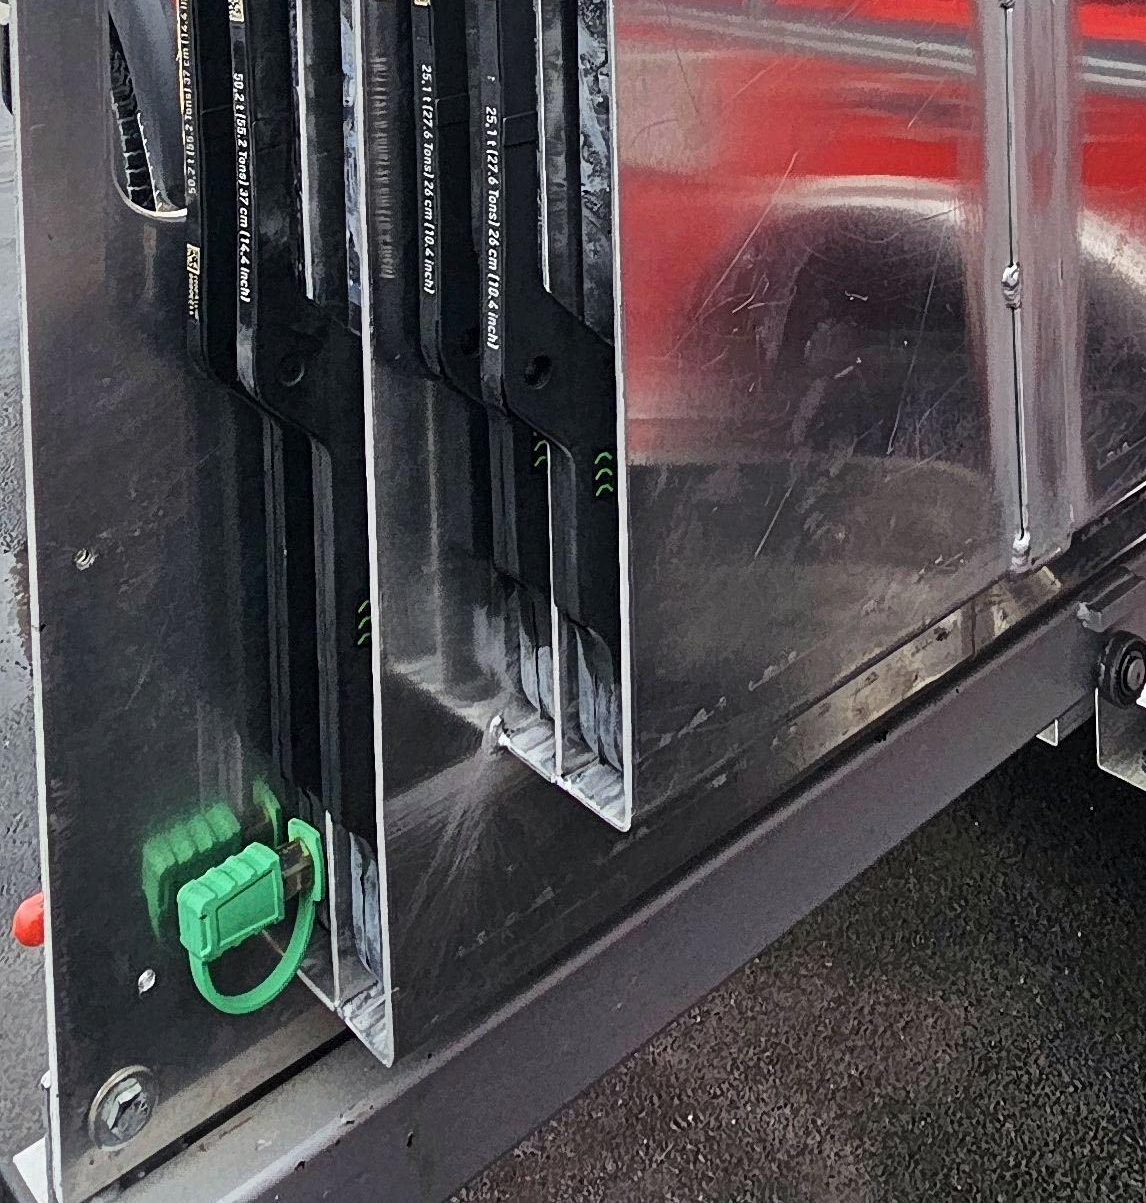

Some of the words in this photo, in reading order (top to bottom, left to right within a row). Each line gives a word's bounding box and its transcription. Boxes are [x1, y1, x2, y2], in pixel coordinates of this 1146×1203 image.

[421, 105, 435, 139] (27.6
[237, 151, 250, 186] Tons)
[423, 143, 435, 178] Tons)
[485, 149, 500, 186] (27.6
[238, 188, 249, 206] 37
[424, 180, 434, 197] 26
[239, 207, 249, 228] cm
[424, 199, 433, 220] cm
[487, 190, 500, 227] Tons)
[239, 231, 251, 264] (14.4
[423, 222, 436, 256] (10.4
[488, 229, 500, 247] 26
[488, 248, 498, 270] cm
[239, 267, 252, 303] inch)
[423, 259, 436, 295] inch)
[486, 273, 500, 309] (10.4
[486, 312, 499, 350] inch)
